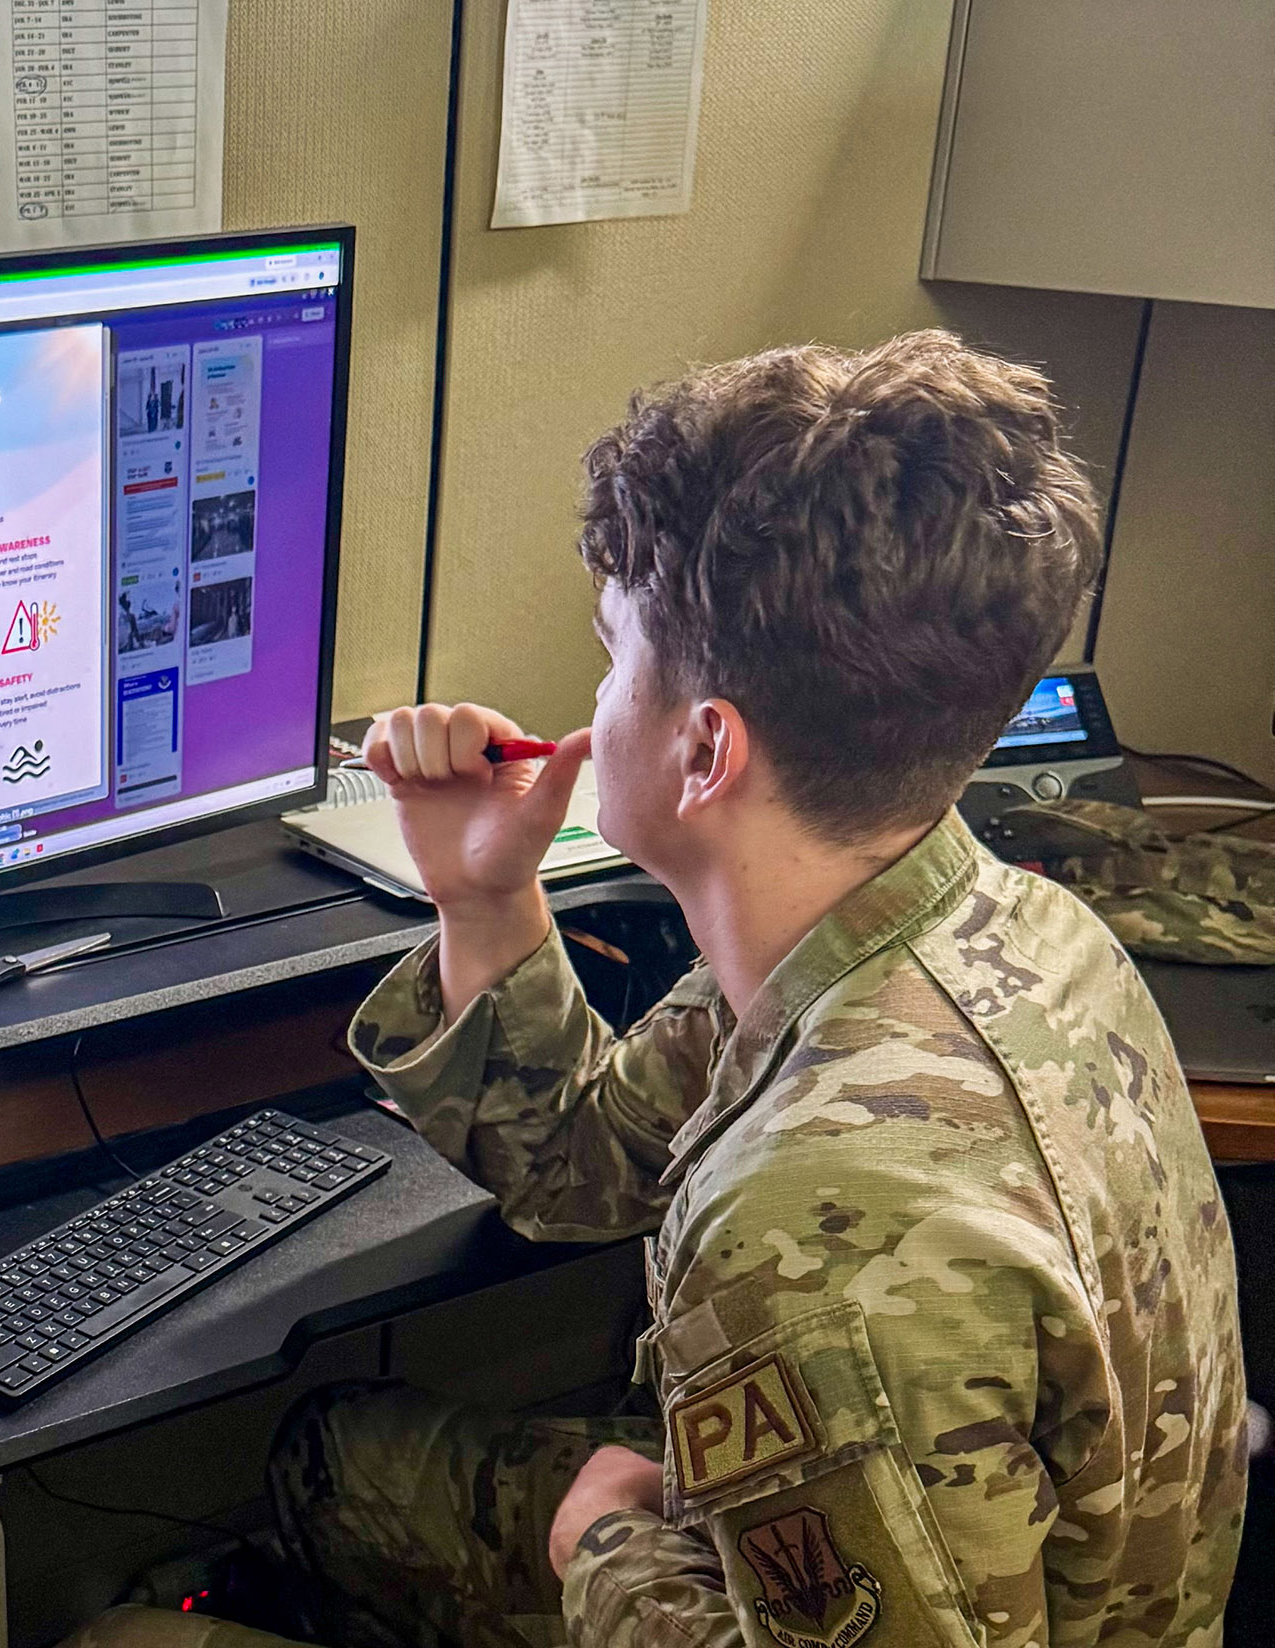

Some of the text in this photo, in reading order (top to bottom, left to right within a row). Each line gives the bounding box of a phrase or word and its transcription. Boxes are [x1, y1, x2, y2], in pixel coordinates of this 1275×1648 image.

[0, 673, 32, 687] SAFETY
[683, 1380, 797, 1482] PA
[777, 1630, 798, 1648] AIR
[835, 1601, 874, 1648] COMMAND
